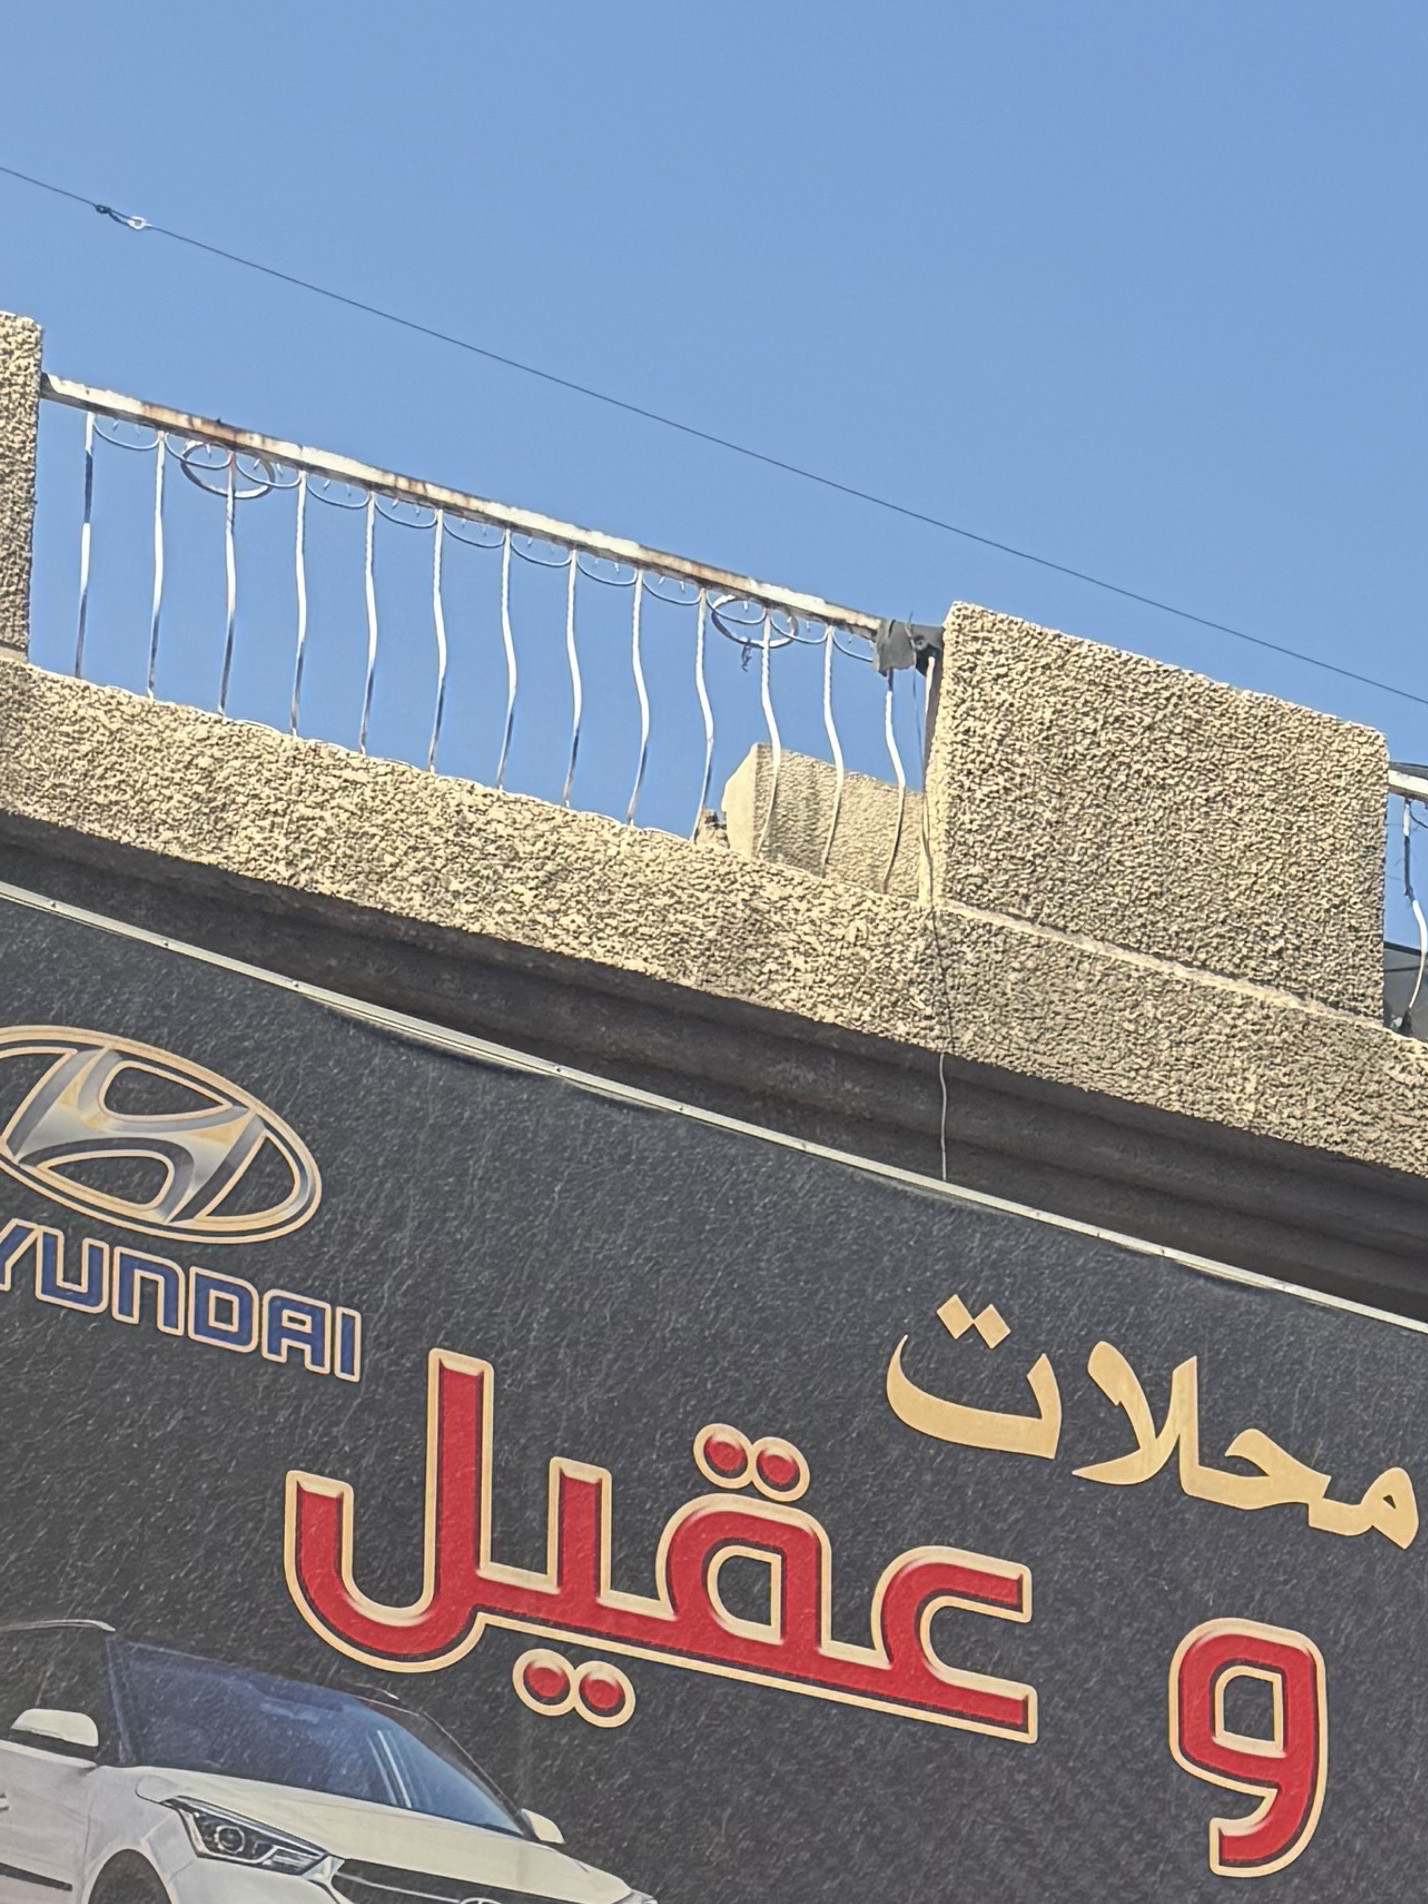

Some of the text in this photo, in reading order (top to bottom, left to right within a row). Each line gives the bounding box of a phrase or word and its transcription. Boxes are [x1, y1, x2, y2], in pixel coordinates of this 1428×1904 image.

[0, 1217, 362, 1382] YUNDAI
[887, 1293, 1419, 1549] محلات
[284, 1348, 1038, 1744] عقيل
[1169, 1617, 1328, 1878] و
